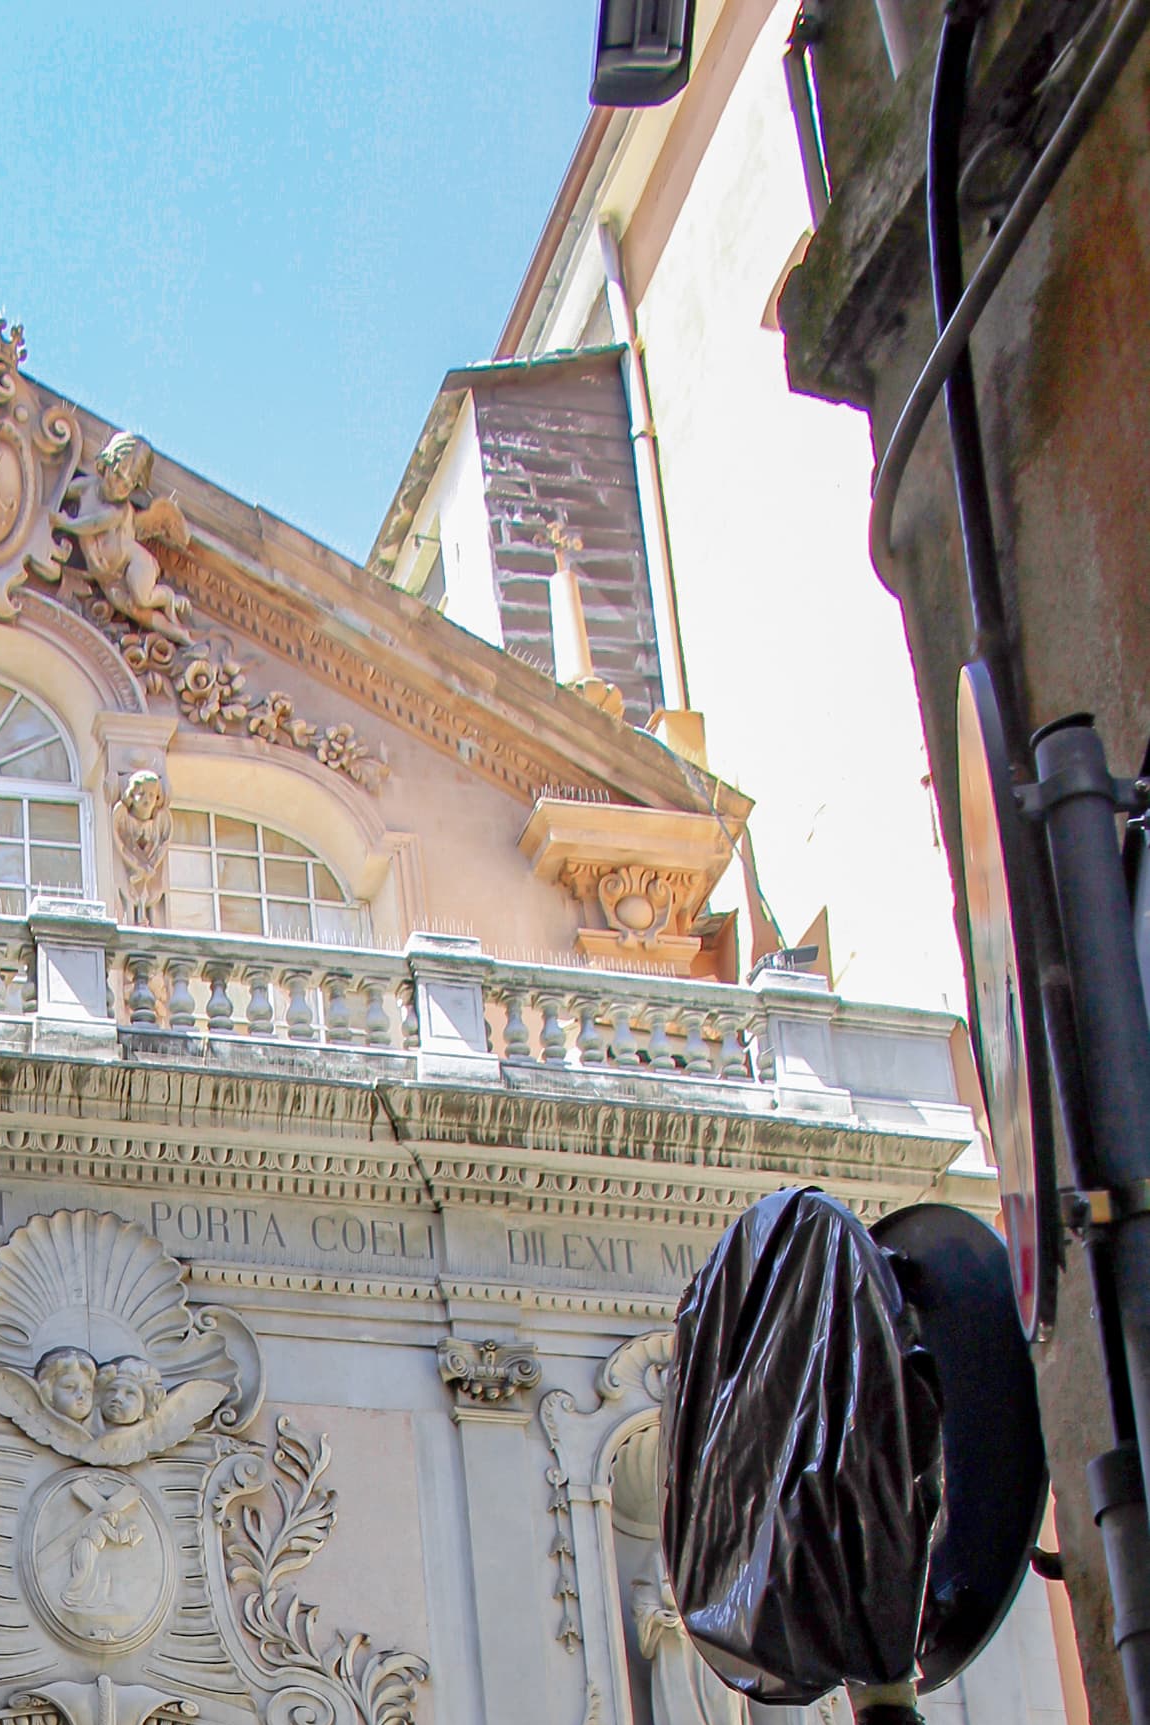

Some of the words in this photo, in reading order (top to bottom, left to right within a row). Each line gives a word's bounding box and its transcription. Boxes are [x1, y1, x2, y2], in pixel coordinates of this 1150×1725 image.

[151, 1201, 287, 1248] PORTA
[311, 1215, 436, 1260] COELI
[507, 1229, 639, 1275] DILEXIT
